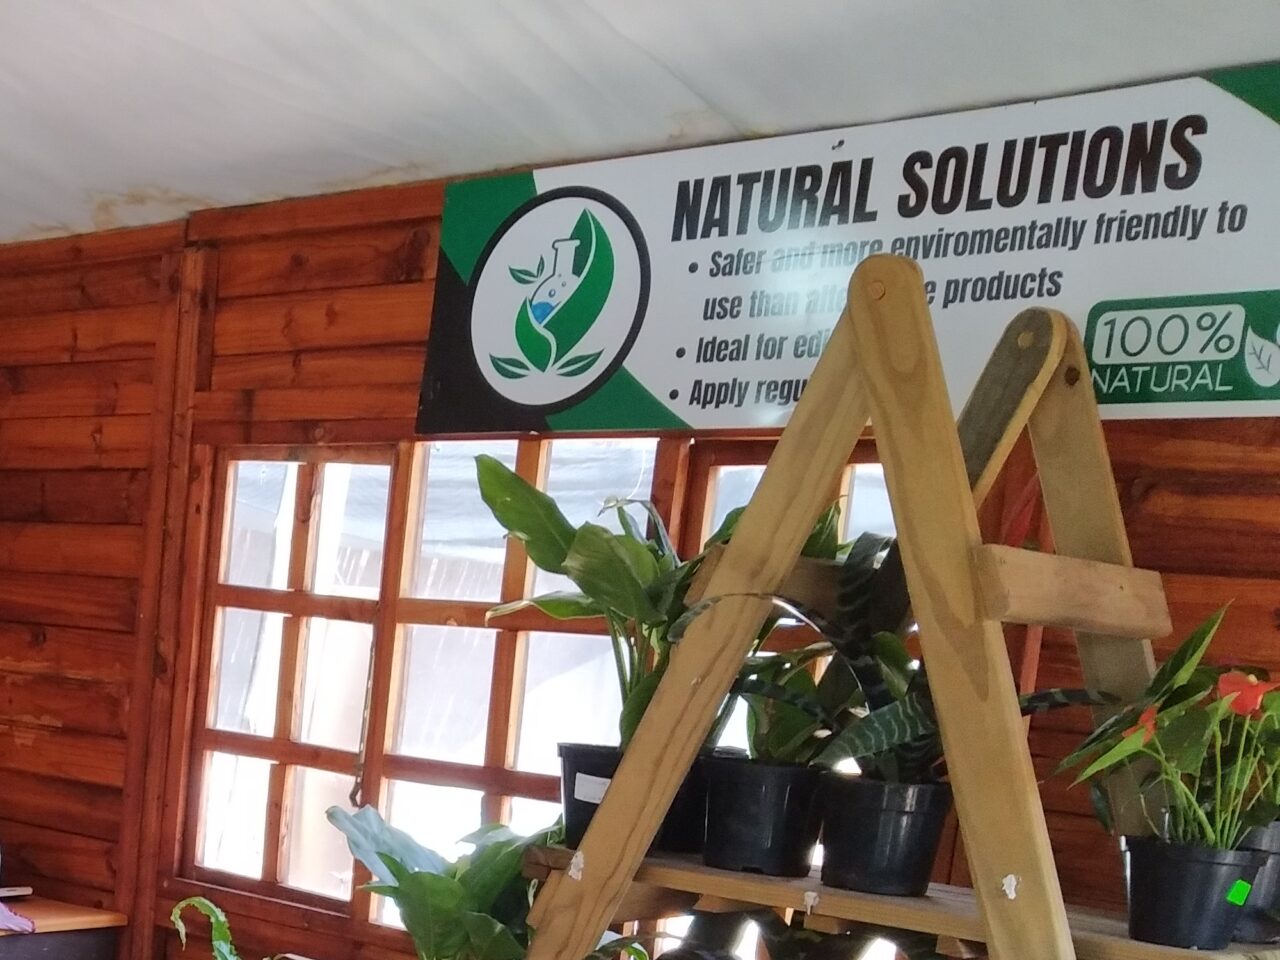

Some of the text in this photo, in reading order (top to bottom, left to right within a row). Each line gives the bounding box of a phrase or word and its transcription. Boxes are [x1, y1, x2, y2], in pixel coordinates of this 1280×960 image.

[671, 113, 1209, 242] NATURAL SOLUTIONS
[708, 248, 768, 278] Safer
[771, 241, 817, 274] and
[890, 215, 1088, 261] enviromentally
[1093, 203, 1209, 246] friendly
[1216, 200, 1249, 235] to
[702, 294, 743, 321] use
[748, 289, 800, 319] than
[942, 267, 1064, 309] products
[695, 333, 751, 364] Ideal
[754, 332, 789, 361] for
[1103, 310, 1236, 359] 100%
[688, 377, 751, 410] Apply
[1091, 363, 1234, 395] NATURAL
